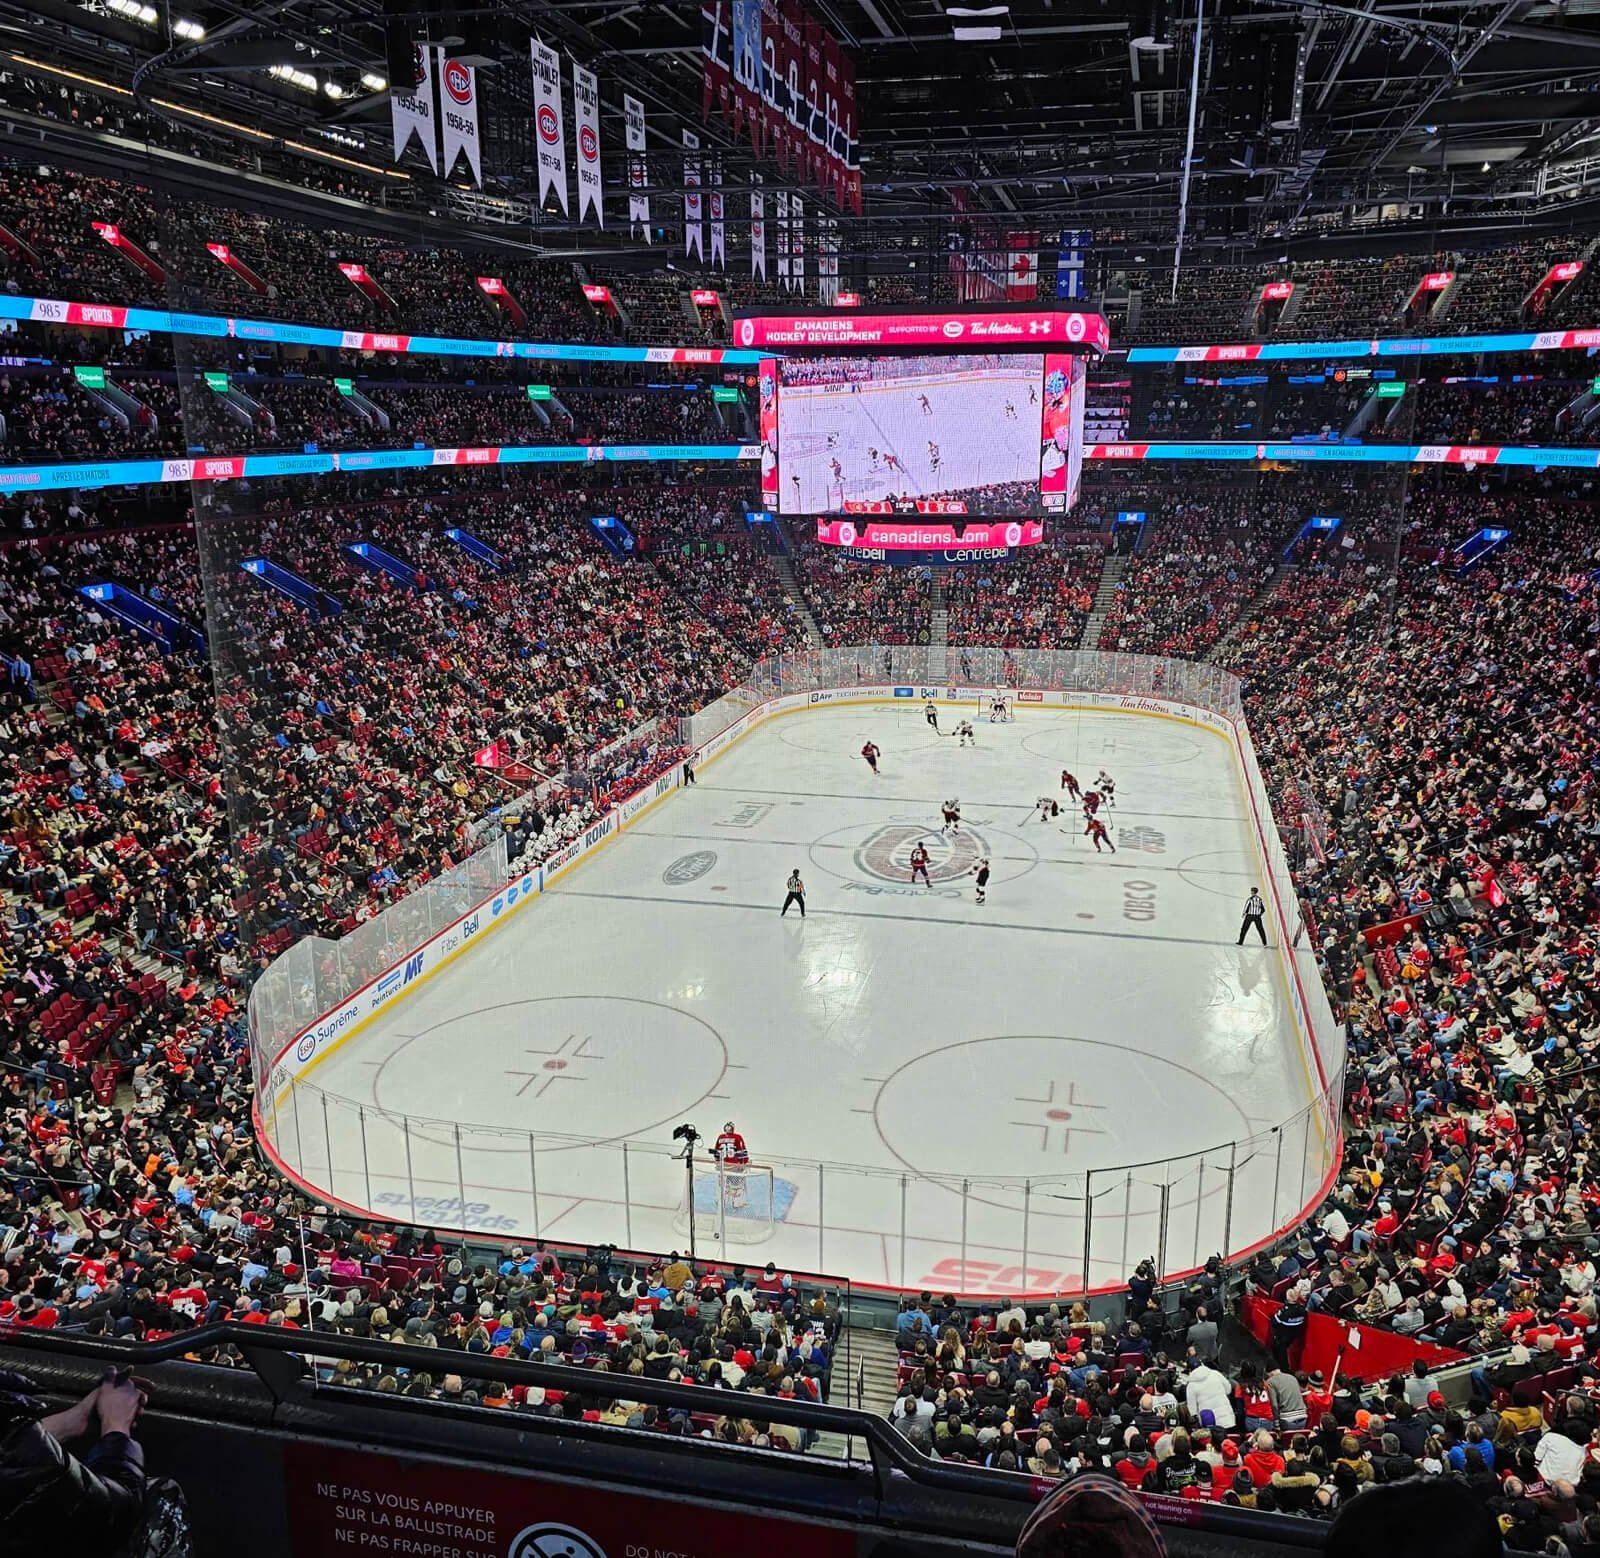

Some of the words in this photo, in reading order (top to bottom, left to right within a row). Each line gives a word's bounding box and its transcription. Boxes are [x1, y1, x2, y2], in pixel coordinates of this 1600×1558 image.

[532, 61, 559, 88] STANLEY
[575, 82, 597, 109] STANLEY
[446, 111, 474, 136] 1958-59
[81, 307, 113, 323] SPORTS
[794, 321, 853, 331] CANADIENS
[889, 326, 927, 334] SUPPORTED
[970, 322, 987, 335] Tim
[989, 322, 1024, 335] Hortons
[766, 332, 805, 342] HOCKEY
[807, 331, 882, 342] DEVELOPMENT
[685, 351, 712, 361] SPORTS
[824, 384, 845, 393] MNP
[1105, 447, 1133, 457] SPORTS
[205, 461, 234, 476] SPORTS
[920, 687, 938, 699] Bell
[1119, 696, 1136, 708] Tim
[1137, 698, 1169, 714] Hortons
[585, 816, 613, 849] RONA
[463, 912, 479, 939] Bell
[403, 951, 425, 985] MF
[371, 982, 402, 1008] Peintures
[317, 1006, 358, 1042] Suprême
[299, 1040, 314, 1057] Esso
[373, 1191, 492, 1216] experts
[417, 1207, 520, 1231] sports
[317, 1482, 338, 1498] NE
[343, 1487, 372, 1504] PAS
[374, 1492, 420, 1512] VOUS
[423, 1500, 496, 1525] APPUYER
[1145, 1501, 1157, 1509] not
[1157, 1502, 1182, 1514] leaning
[335, 1505, 367, 1522] SUR
[371, 1511, 391, 1526] LA
[394, 1514, 497, 1544] BALUSTRADE
[335, 1527, 356, 1544] NE
[360, 1532, 389, 1549] PAS
[393, 1538, 462, 1558] FRAPPER
[625, 1544, 649, 1558] DO
